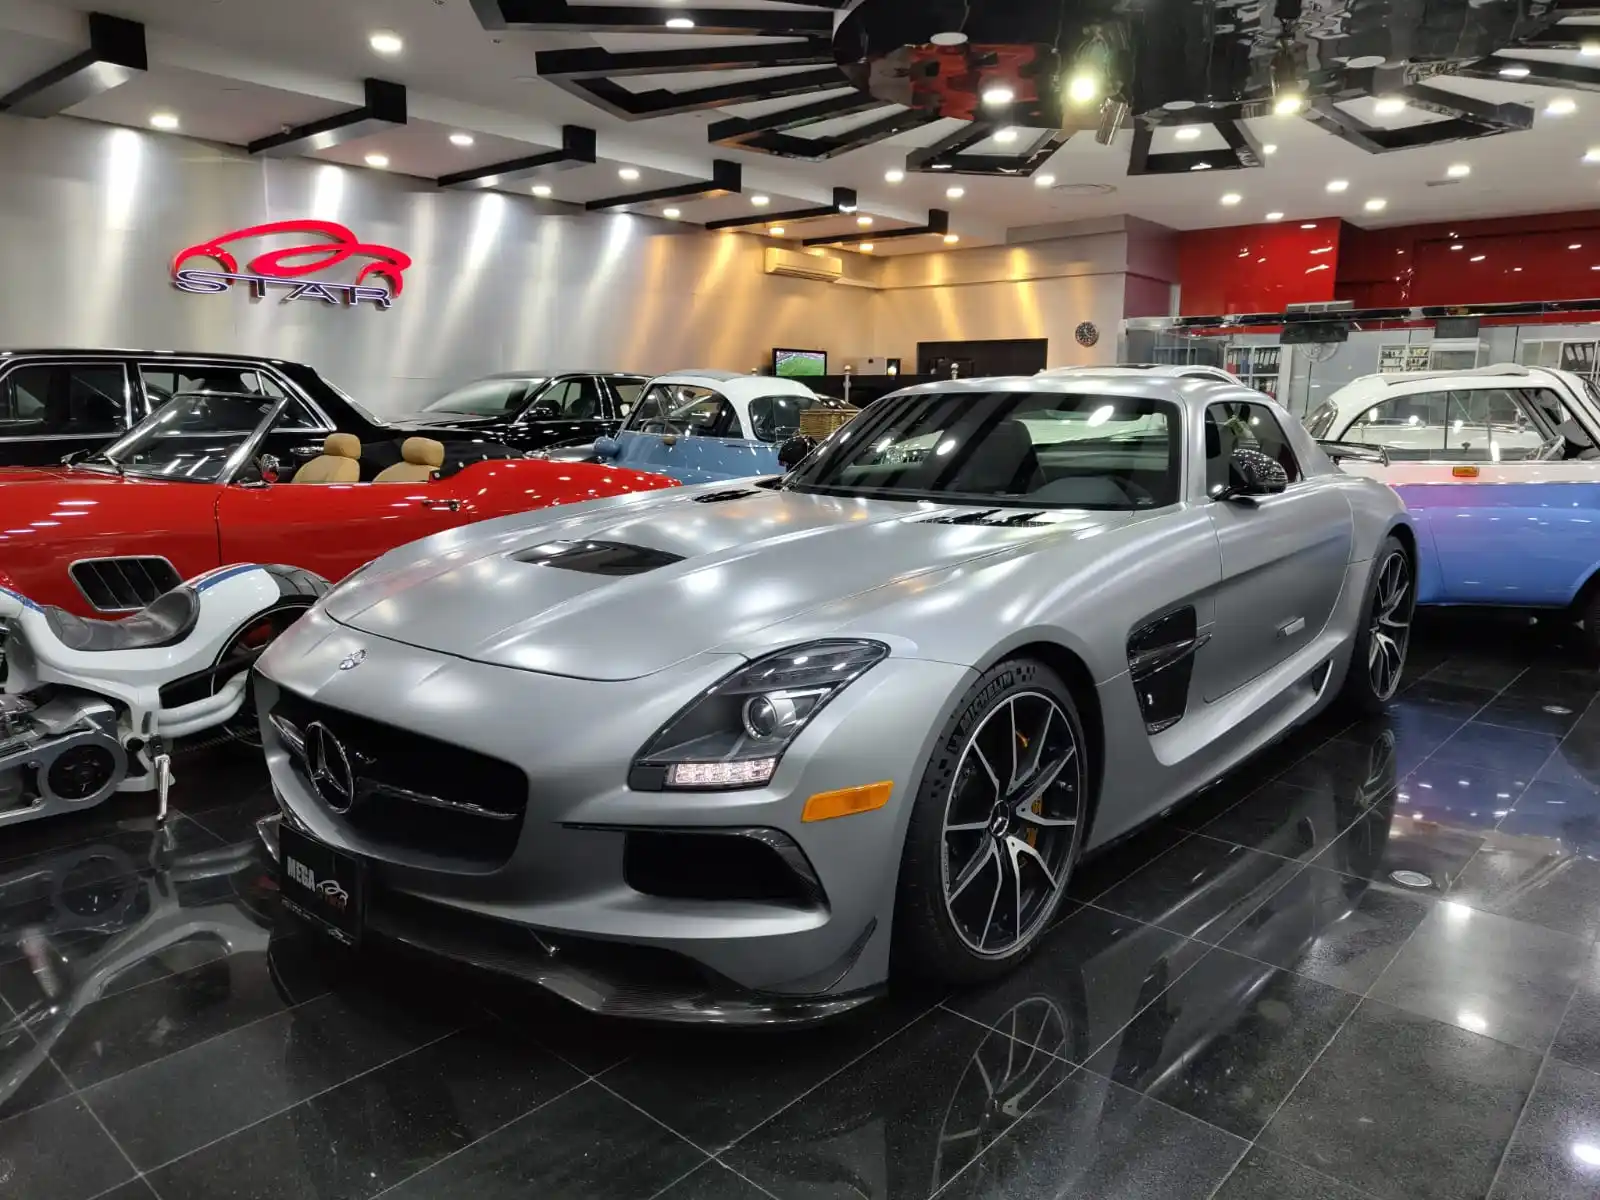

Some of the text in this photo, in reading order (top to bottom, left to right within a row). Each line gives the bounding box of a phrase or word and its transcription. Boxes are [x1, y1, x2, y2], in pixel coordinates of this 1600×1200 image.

[175, 269, 392, 308] STAR
[959, 670, 1015, 735] MICHELIN
[287, 855, 316, 893] MEGA
